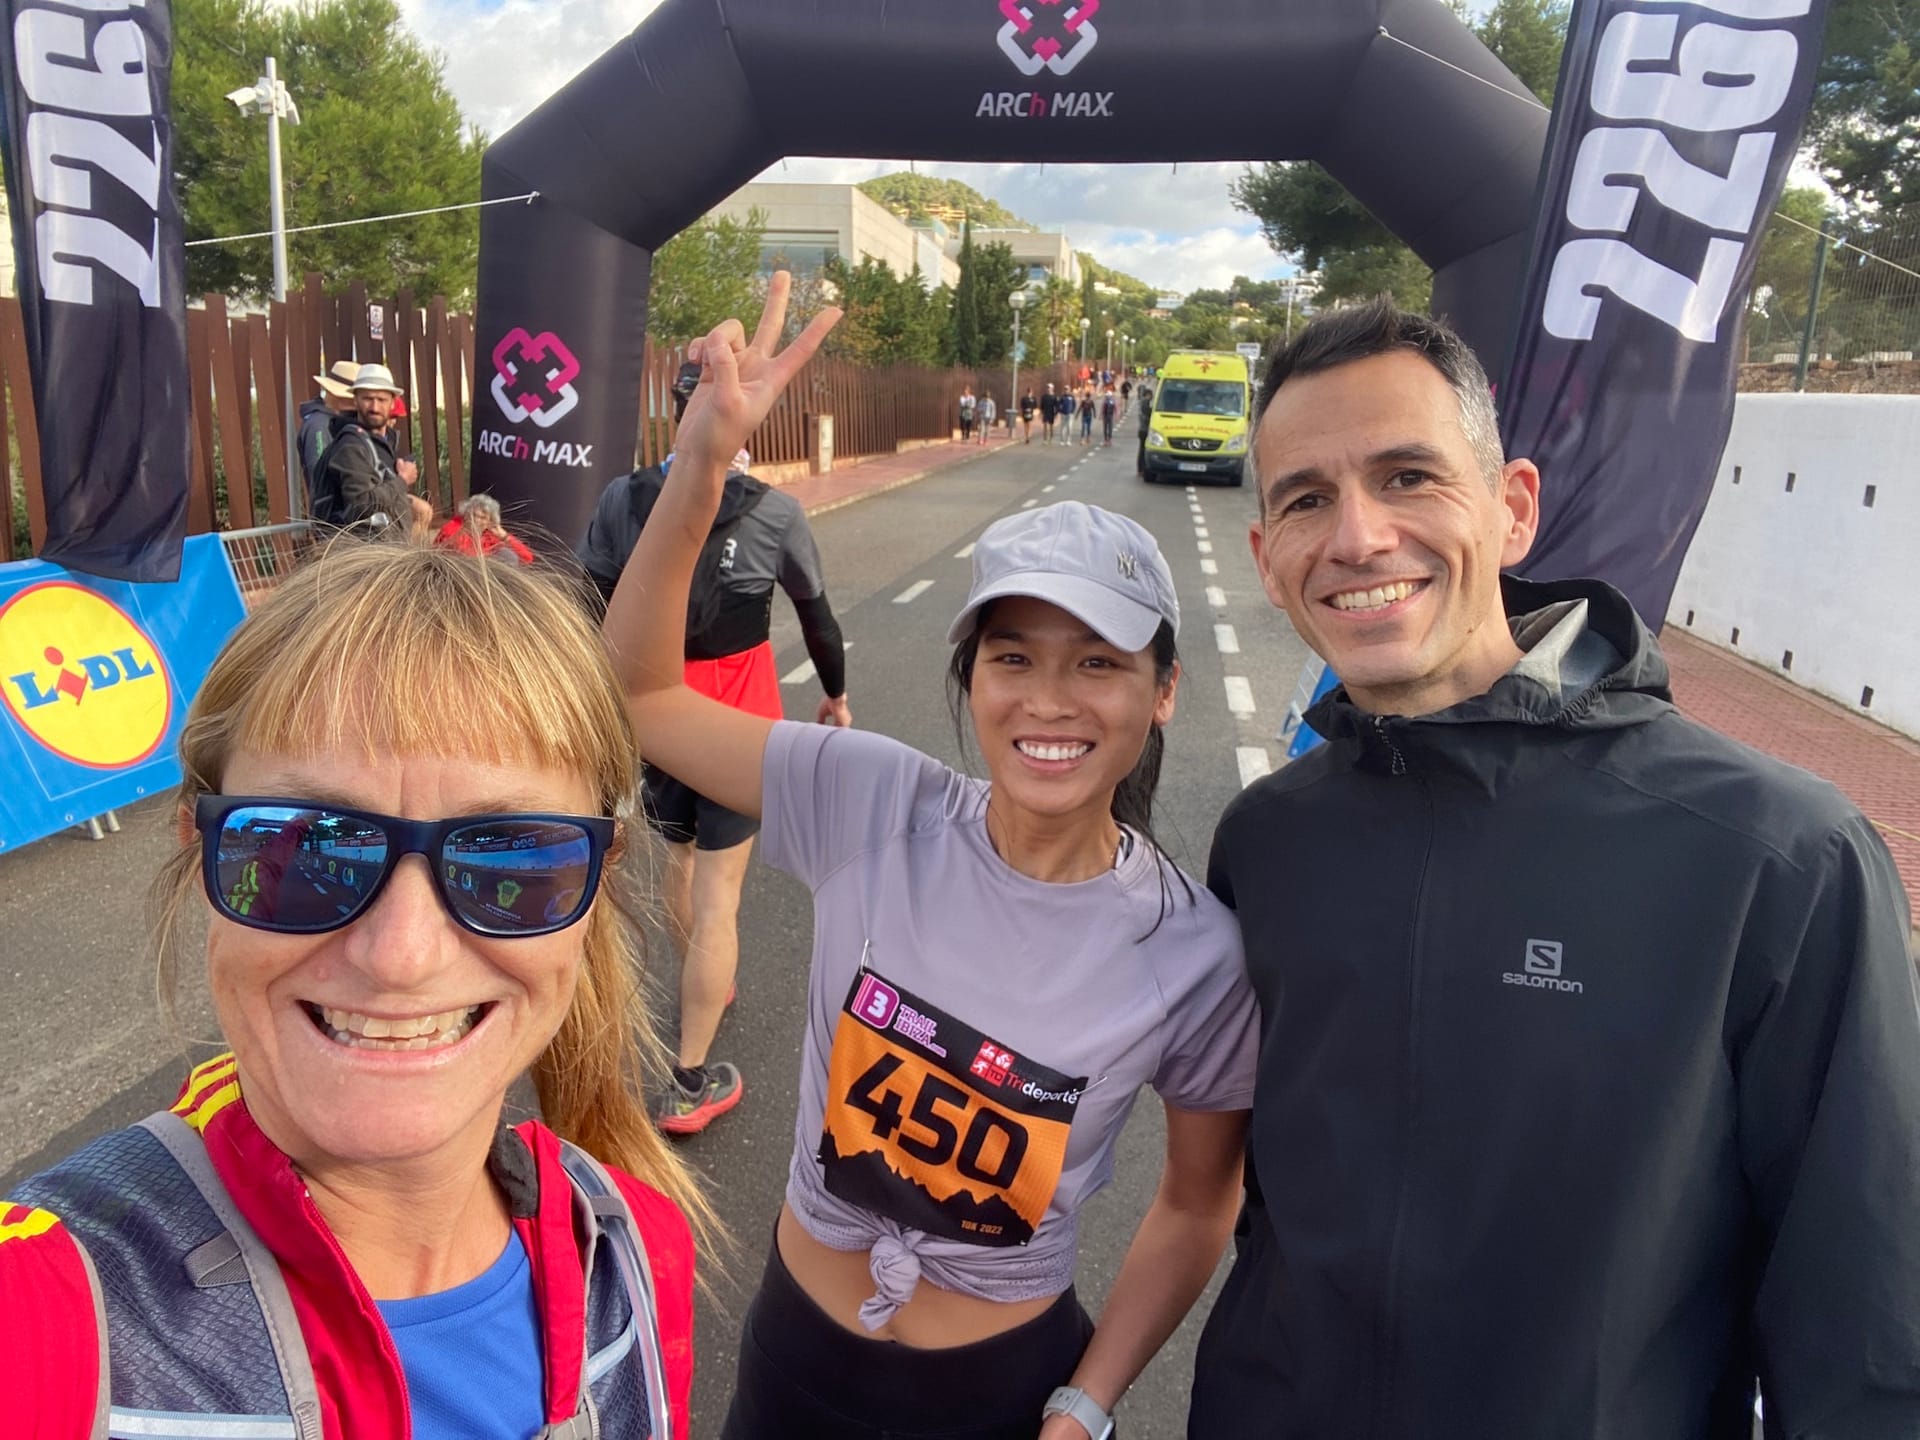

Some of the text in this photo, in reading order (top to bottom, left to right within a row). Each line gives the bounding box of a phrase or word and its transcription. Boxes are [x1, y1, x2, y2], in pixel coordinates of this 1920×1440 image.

[1050, 91, 1114, 117] MAX
[14, 0, 162, 308] 226
[1543, 0, 1814, 343] 226
[533, 439, 593, 467] MAX
[1502, 972, 1584, 994] salomon
[900, 1003, 937, 1036] TRAIL
[844, 1052, 1029, 1190] 450
[980, 1223, 1003, 1235] 2022
